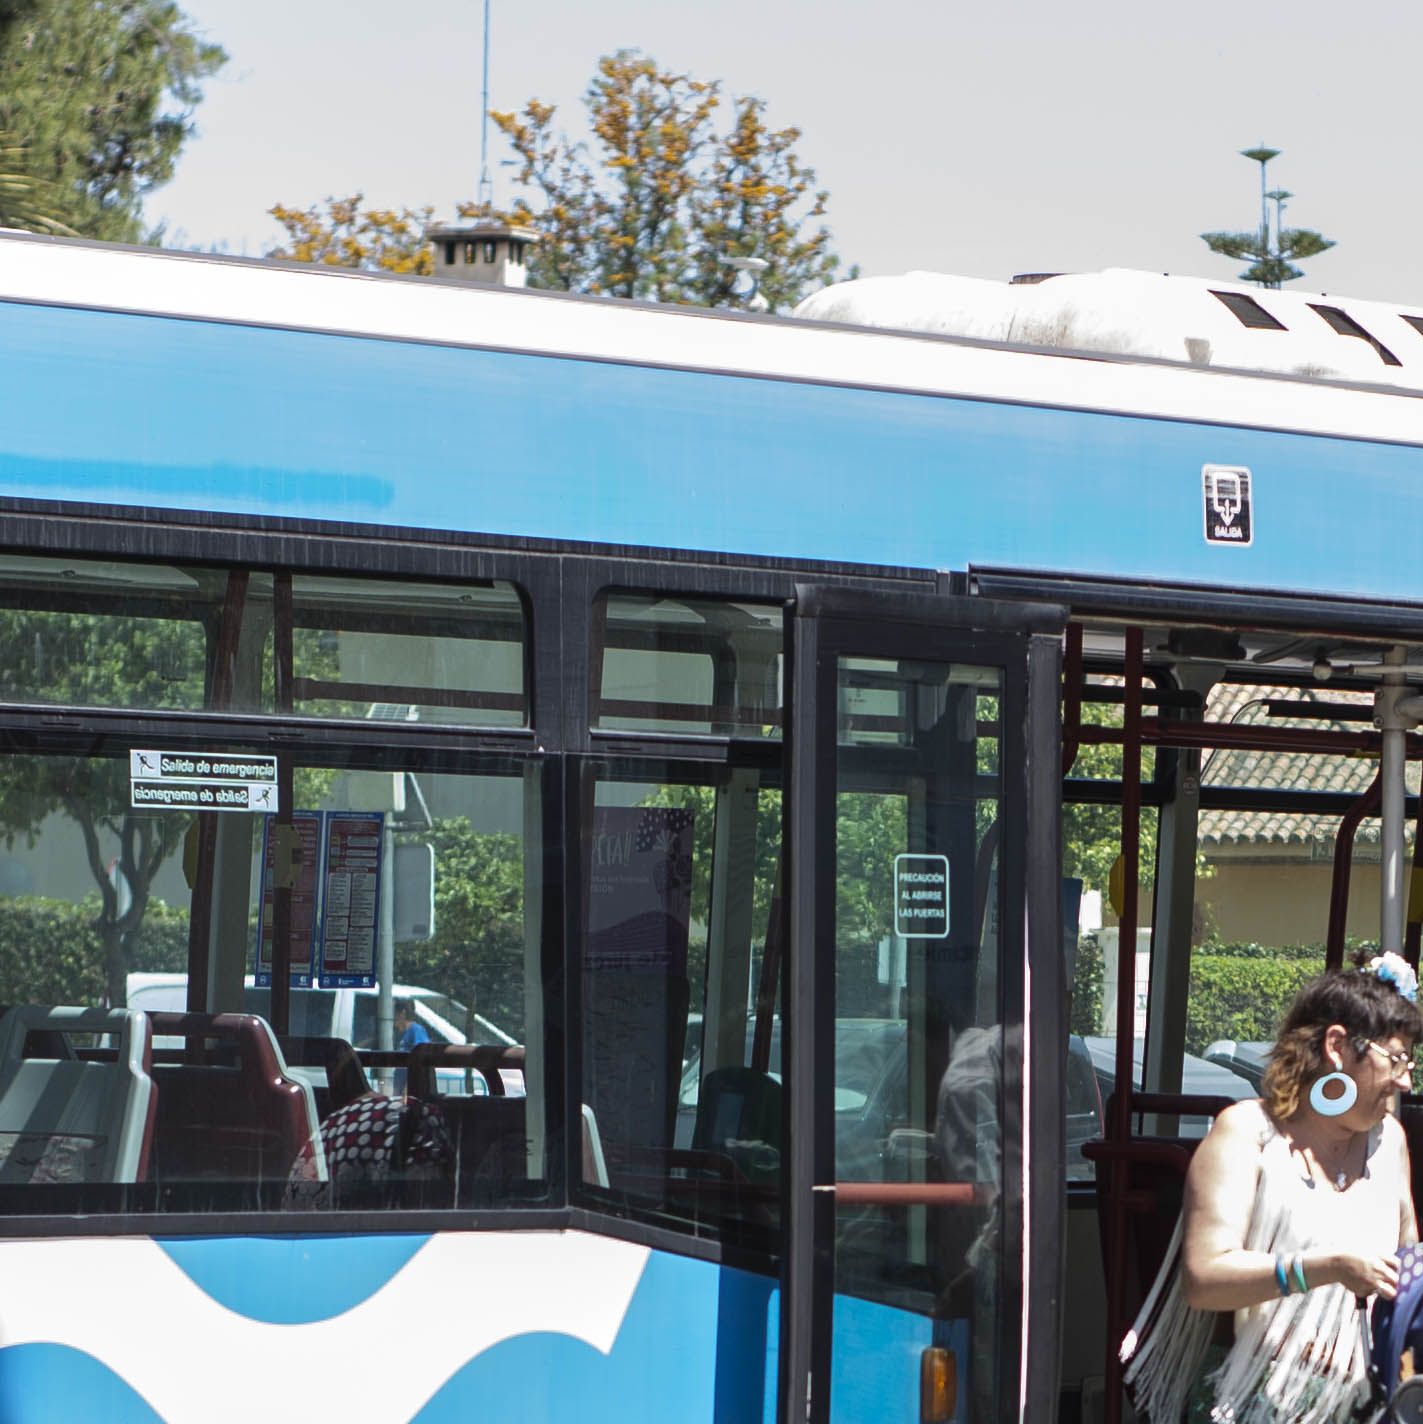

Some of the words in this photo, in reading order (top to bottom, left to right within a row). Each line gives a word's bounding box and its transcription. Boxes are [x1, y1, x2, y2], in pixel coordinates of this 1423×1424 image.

[162, 758, 195, 773] Salida
[196, 760, 210, 774] de
[212, 763, 275, 778] emergencia
[899, 907, 912, 918] LAS
